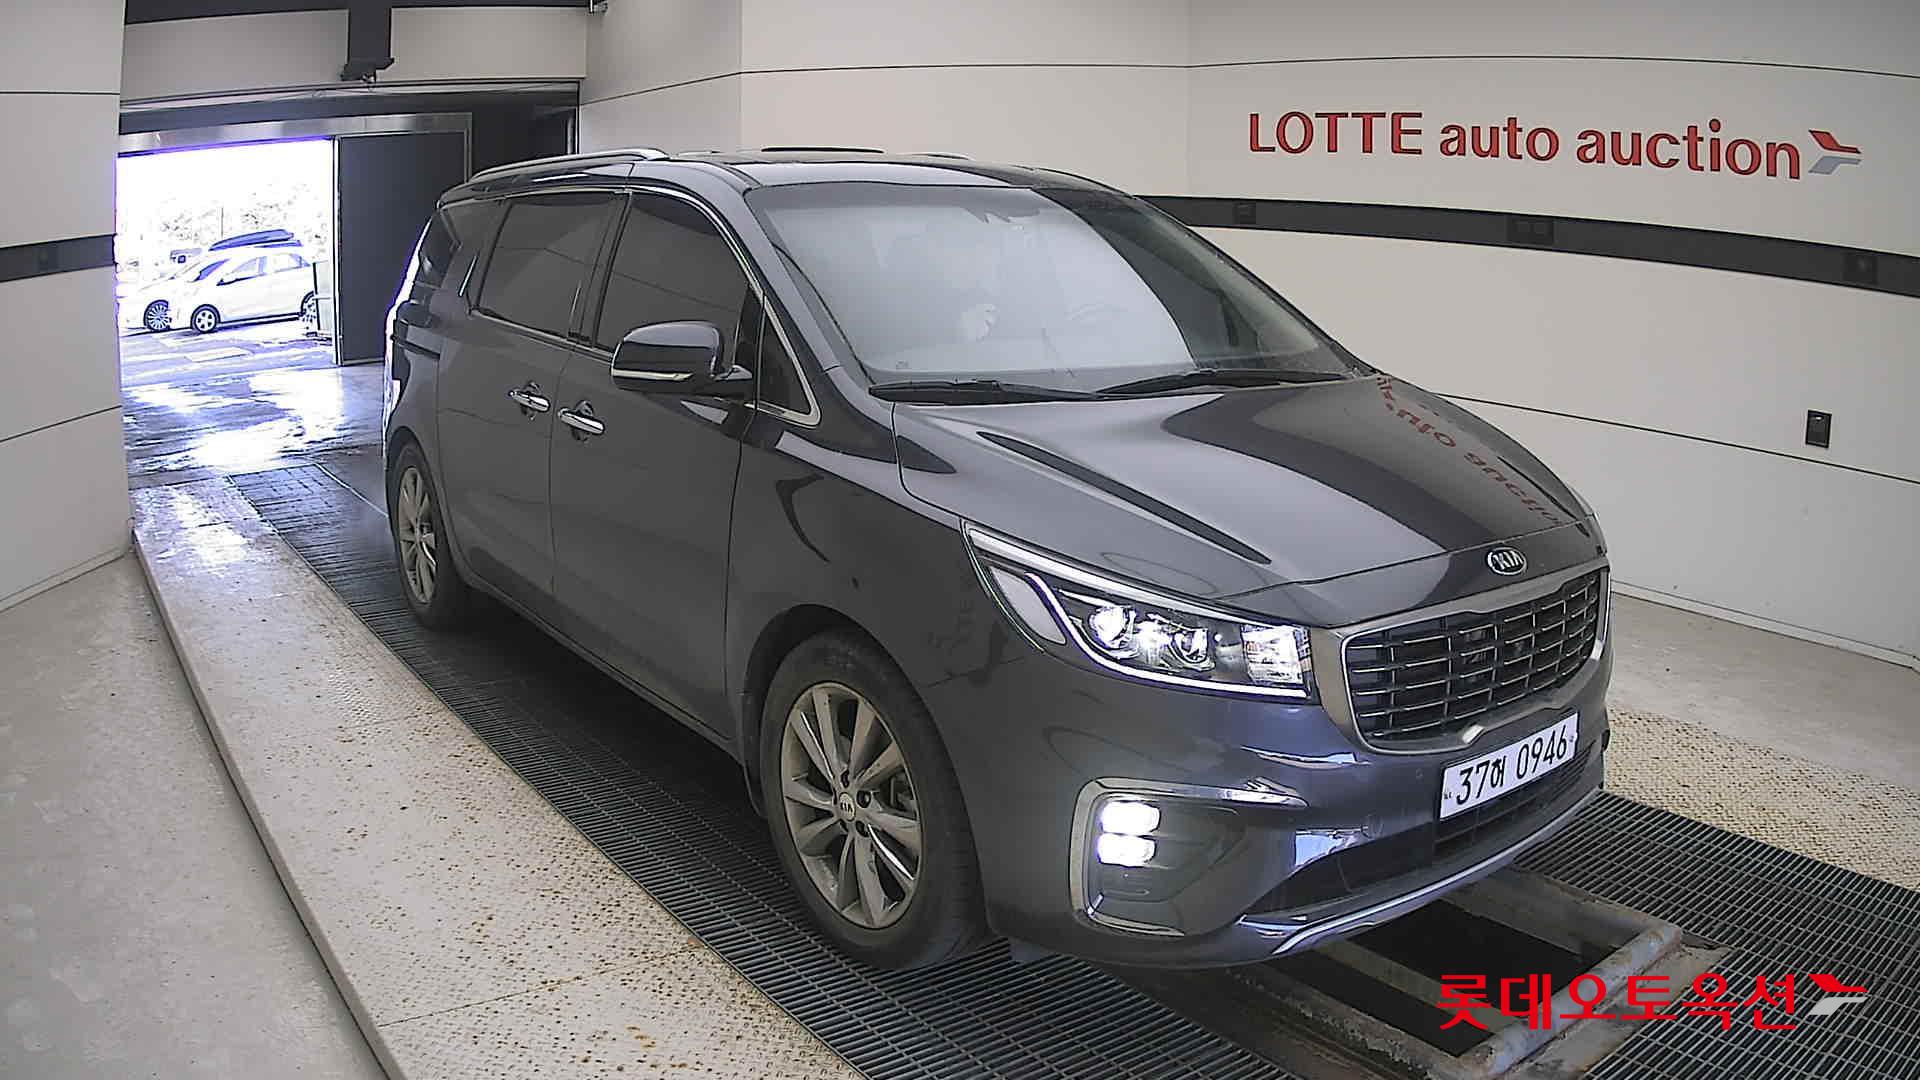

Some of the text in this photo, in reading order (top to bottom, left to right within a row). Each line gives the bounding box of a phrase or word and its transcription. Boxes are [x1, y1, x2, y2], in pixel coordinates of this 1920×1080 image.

[1248, 111, 1801, 181] LOTTE auto auction
[1494, 552, 1524, 571] KIA
[1456, 724, 1568, 805] 37허 0946
